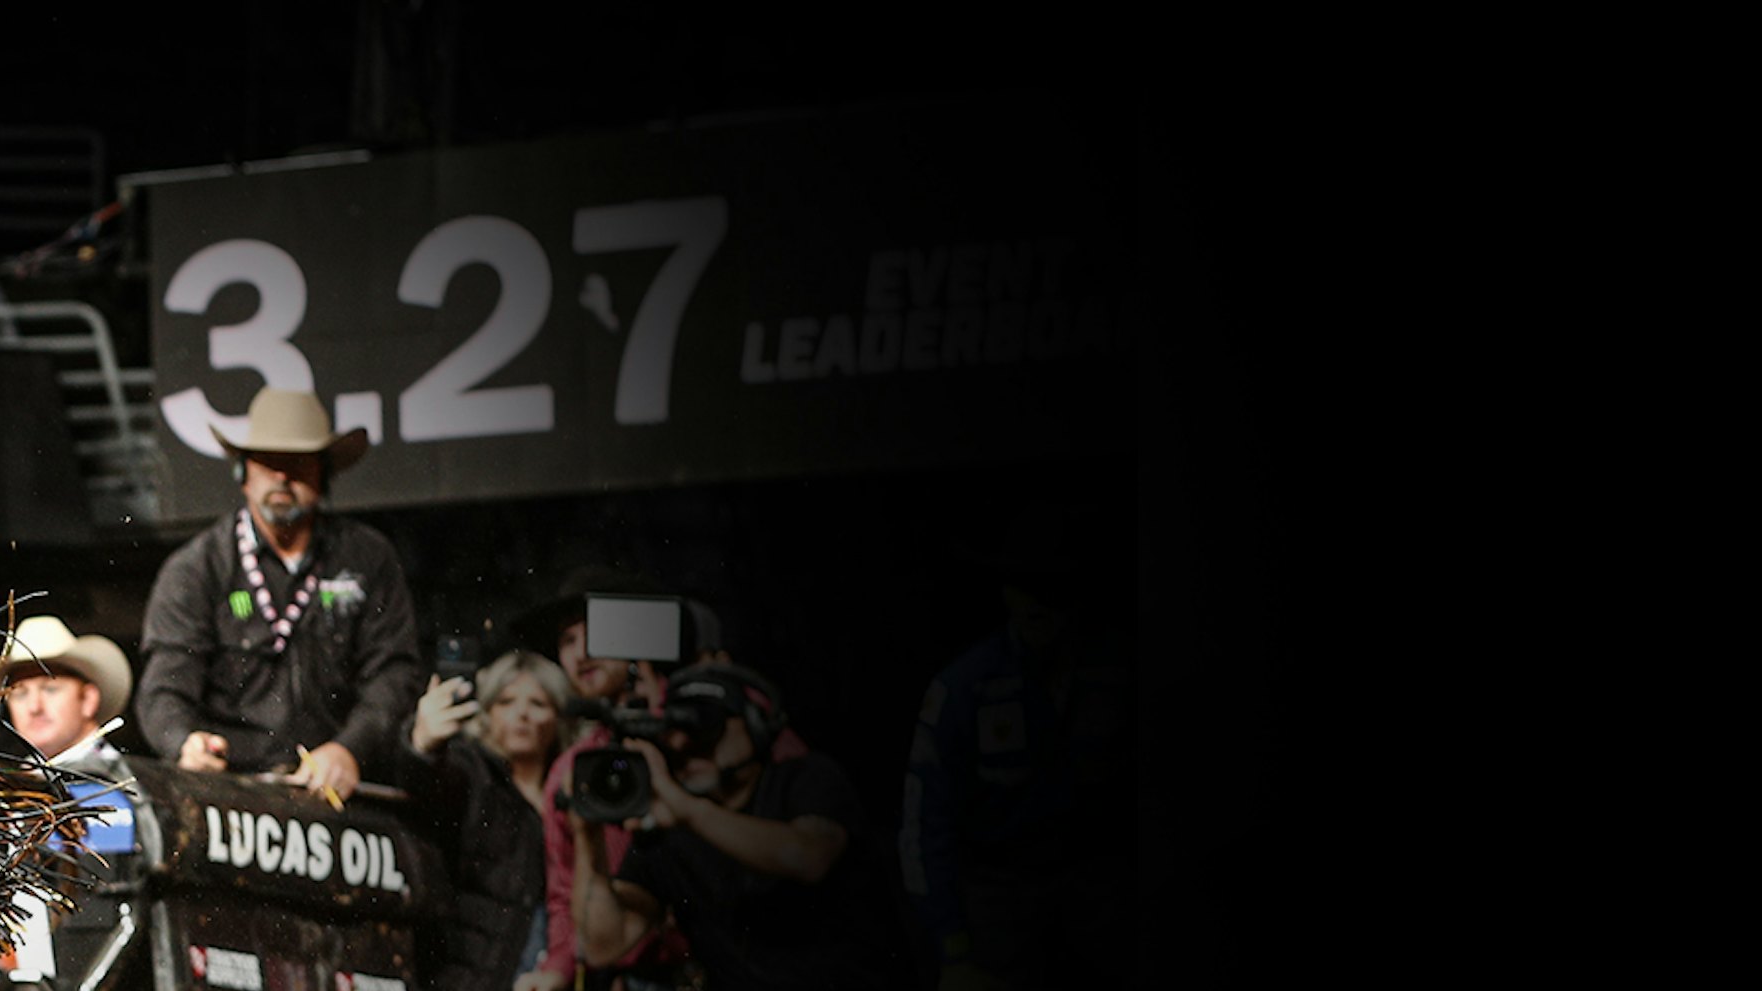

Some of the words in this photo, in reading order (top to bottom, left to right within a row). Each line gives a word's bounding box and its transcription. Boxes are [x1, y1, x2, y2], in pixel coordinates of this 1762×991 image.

[865, 237, 1075, 311] EVENT
[160, 198, 728, 458] 3.27
[205, 804, 334, 882] LUCAS
[340, 826, 406, 893] OIL
